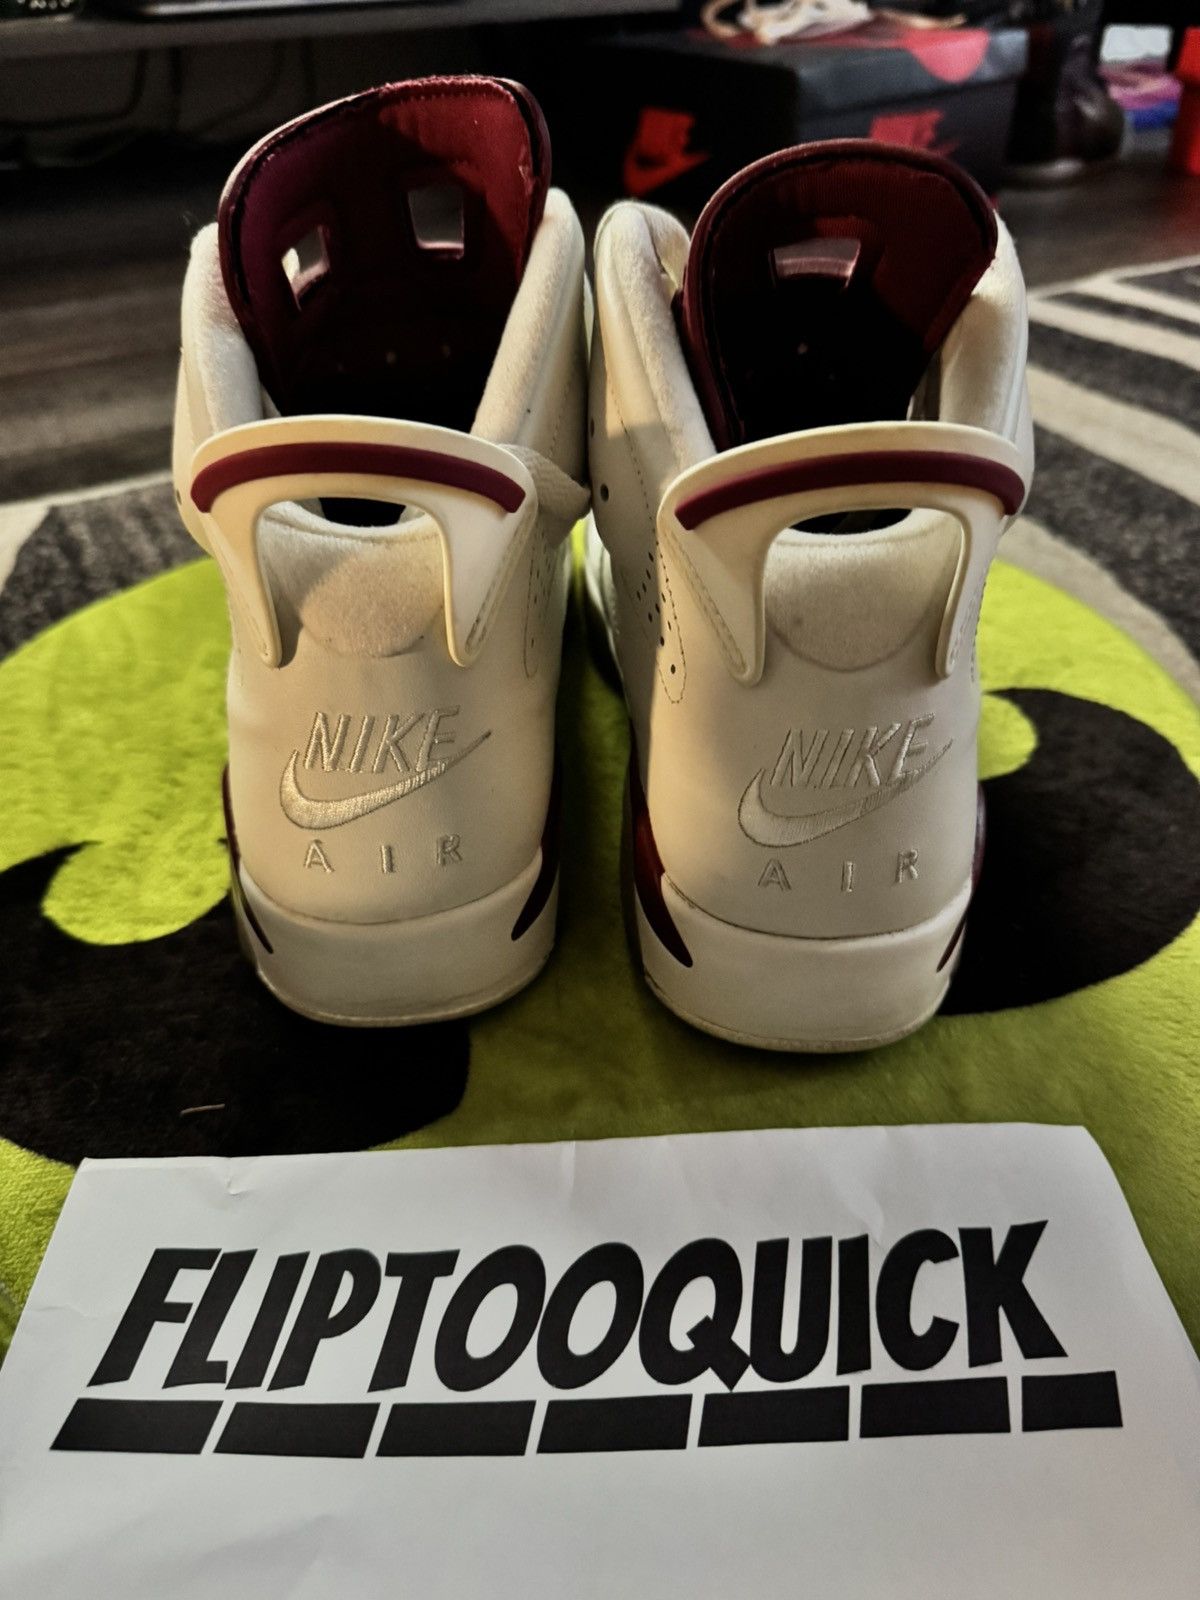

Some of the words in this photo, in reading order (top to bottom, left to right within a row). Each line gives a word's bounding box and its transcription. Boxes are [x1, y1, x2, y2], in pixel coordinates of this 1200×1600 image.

[303, 703, 462, 774] NIKE
[769, 711, 936, 789] NIKE
[87, 1219, 1069, 1393] FLIPTOOQUICK
